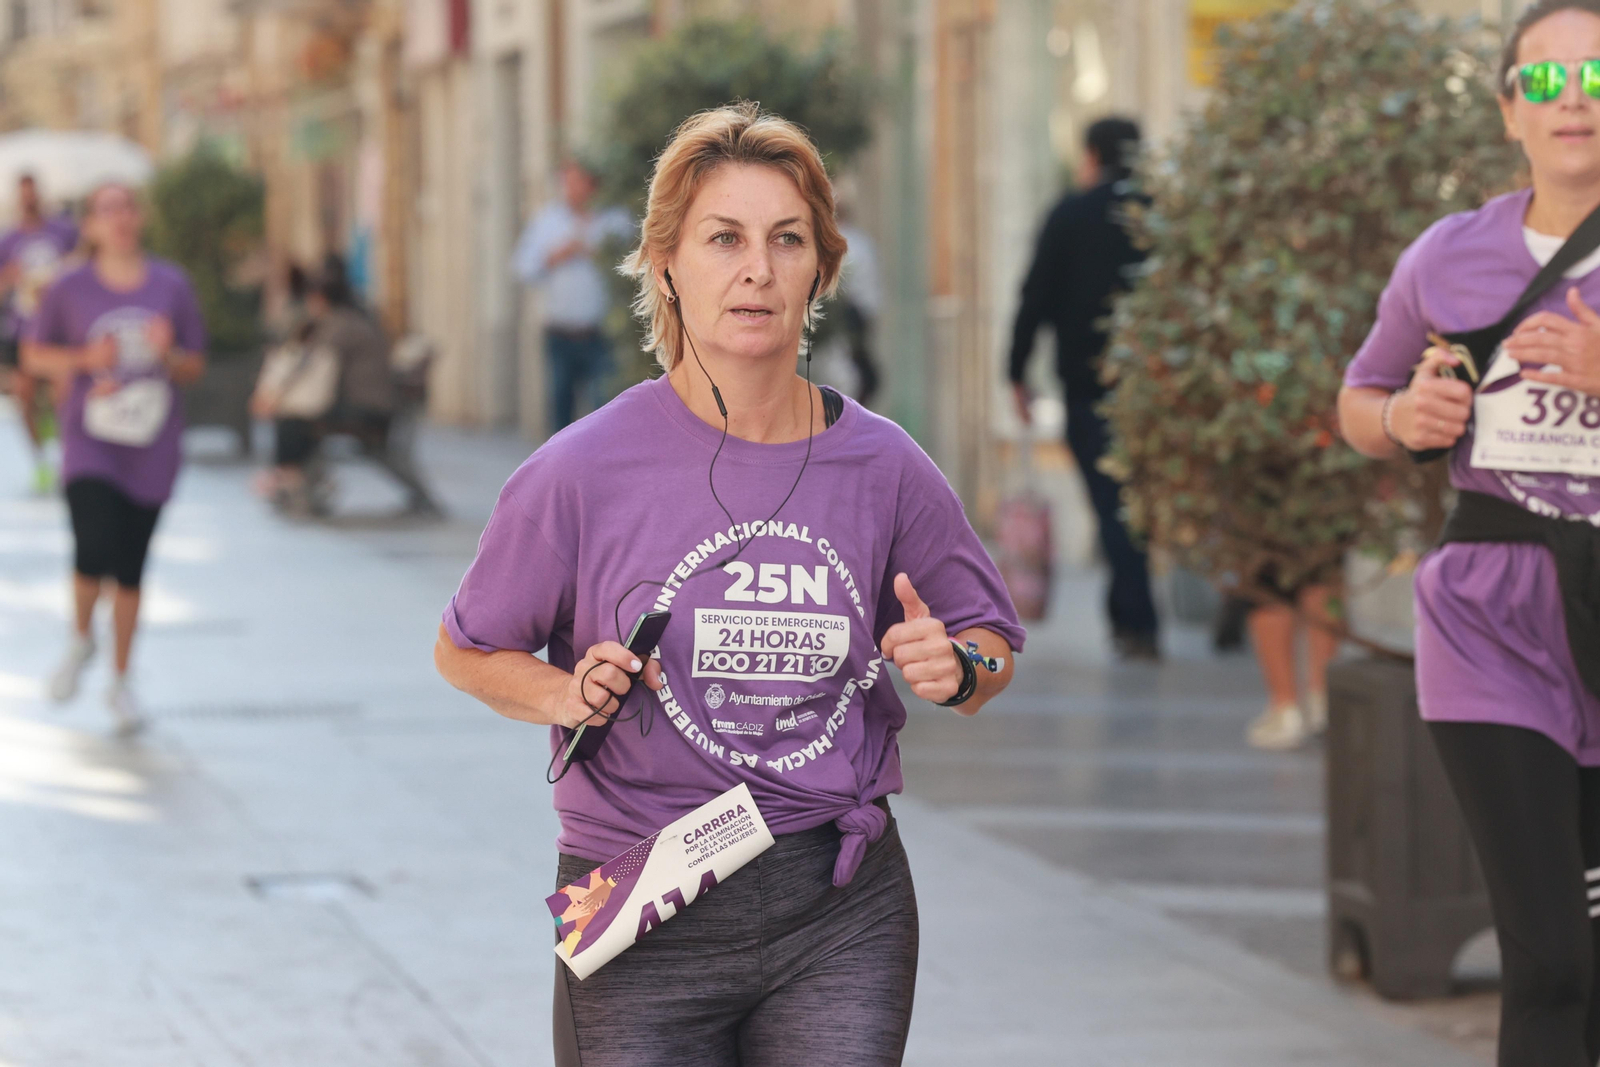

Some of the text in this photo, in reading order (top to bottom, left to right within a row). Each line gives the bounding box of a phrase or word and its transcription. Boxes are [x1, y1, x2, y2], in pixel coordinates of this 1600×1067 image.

[1496, 429, 1586, 447] TOLERANCIA
[653, 520, 813, 611] INTERNACIONAL
[817, 537, 866, 619] CONTRA
[722, 560, 829, 606] 25N
[701, 614, 845, 631] SERVICIO DE EMERGENCIAS
[718, 628, 826, 651] 24 HORAS
[701, 652, 834, 674] 900 21 21 30
[656, 671, 725, 759] MUJERES
[728, 691, 793, 707] Ayuntamiento
[736, 721, 764, 732] CÁDIZ
[729, 750, 759, 769] AS
[683, 803, 748, 844] CARRERA
[685, 813, 752, 855] POR LA ELIMINACIÓN
[699, 821, 755, 854] DE LA VIOLENCIA
[687, 827, 758, 869] CONTRA LAS MUJERES
